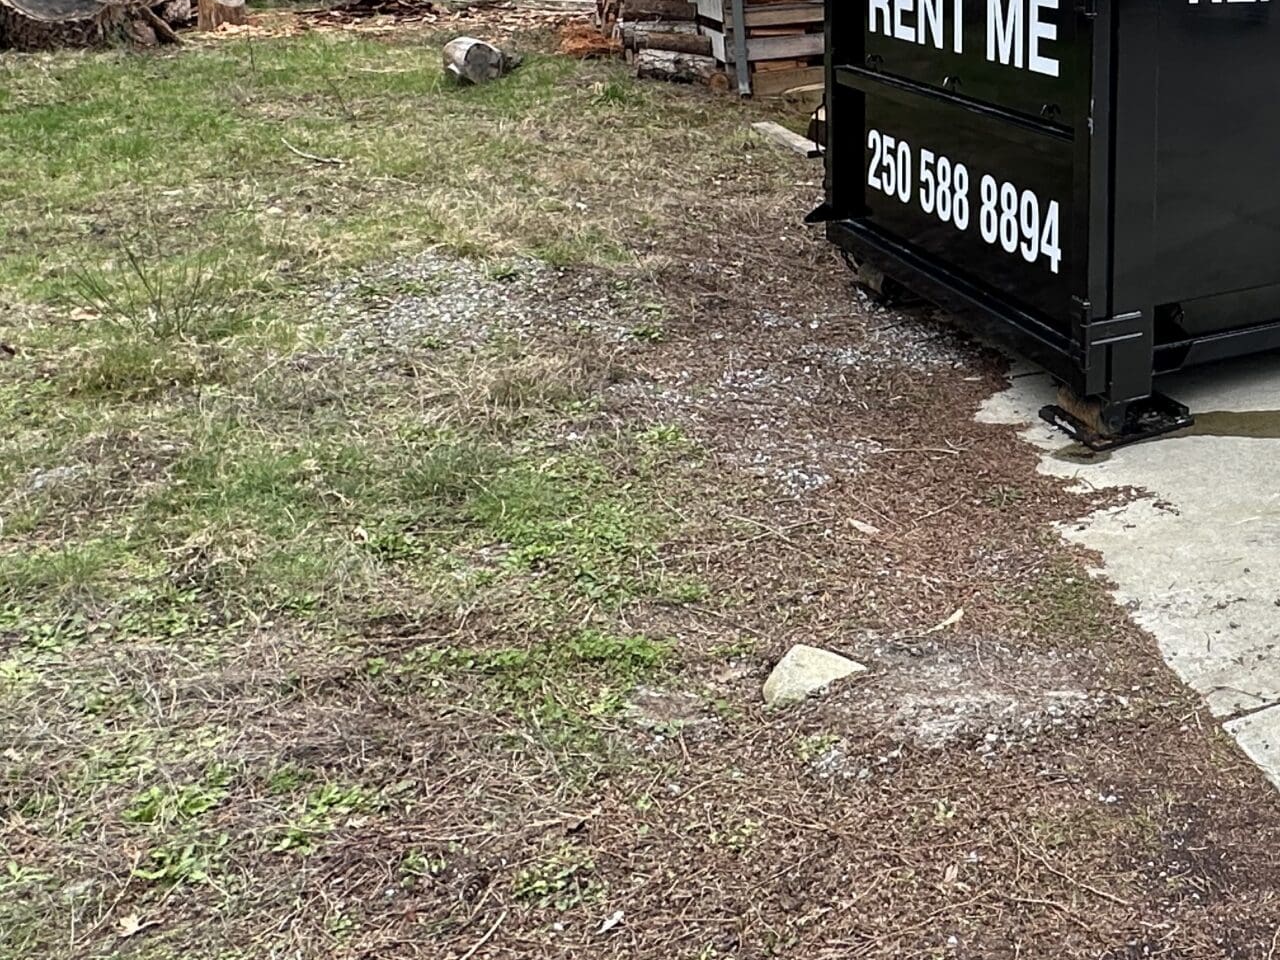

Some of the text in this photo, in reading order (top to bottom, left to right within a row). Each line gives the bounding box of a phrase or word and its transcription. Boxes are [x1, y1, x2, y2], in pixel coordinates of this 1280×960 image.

[867, 129, 1061, 274] 250 588 8894
